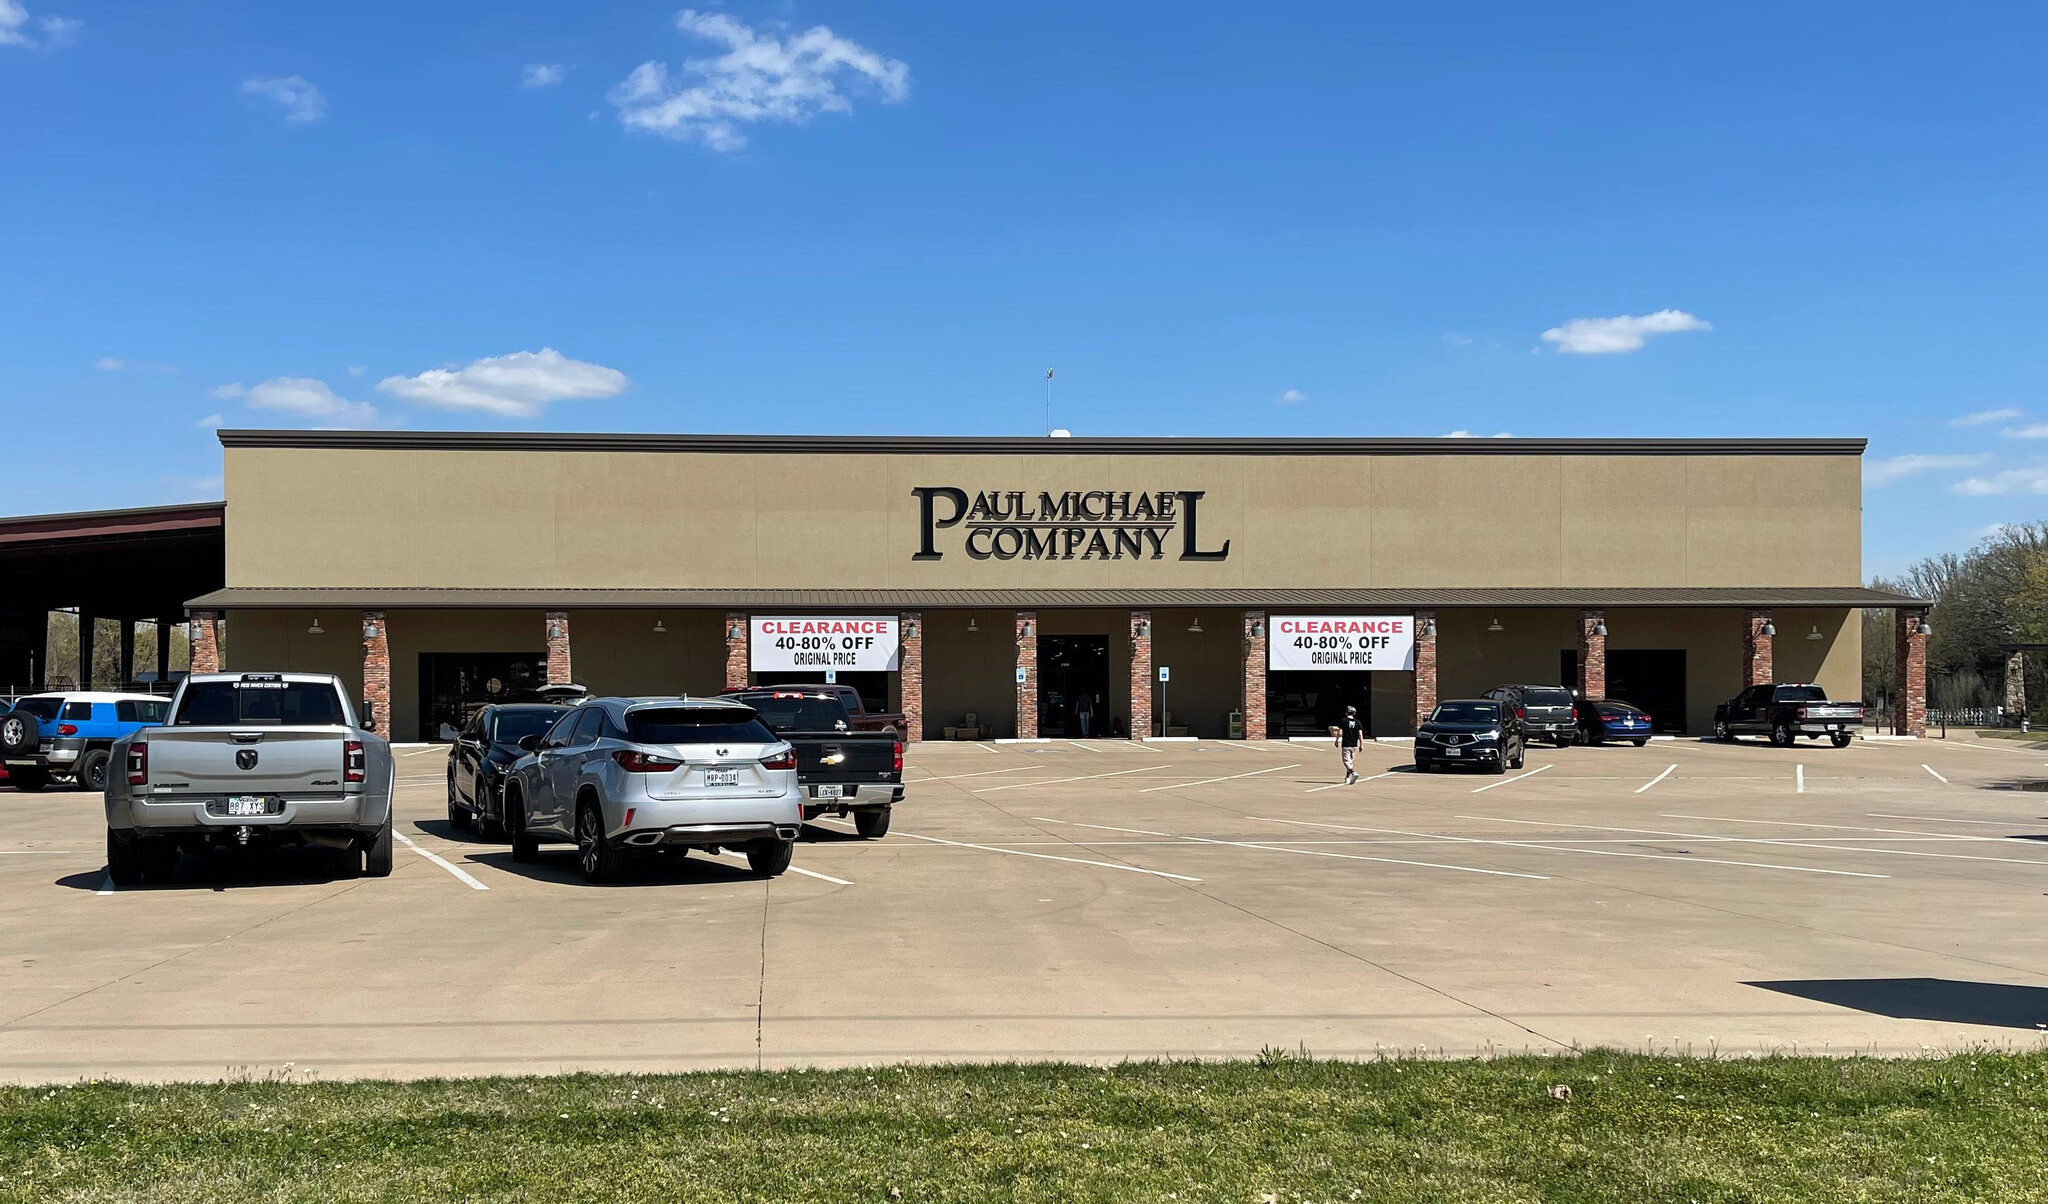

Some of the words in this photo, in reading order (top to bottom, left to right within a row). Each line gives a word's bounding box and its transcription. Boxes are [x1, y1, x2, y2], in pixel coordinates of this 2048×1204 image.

[965, 527, 1172, 561] COMPANY
[762, 621, 887, 634] CLEARANCE
[1280, 621, 1403, 634] CLEARANCE
[775, 637, 836, 650] 40-80%
[842, 637, 874, 649] OFF
[1293, 636, 1353, 649] 40-80%
[1358, 636, 1390, 649] OFF
[794, 652, 831, 665] ORIGINAL
[833, 652, 856, 665] PRICE
[1311, 652, 1347, 664] ORIGINAL
[1349, 652, 1372, 664] PRICE
[230, 802, 244, 810] 887
